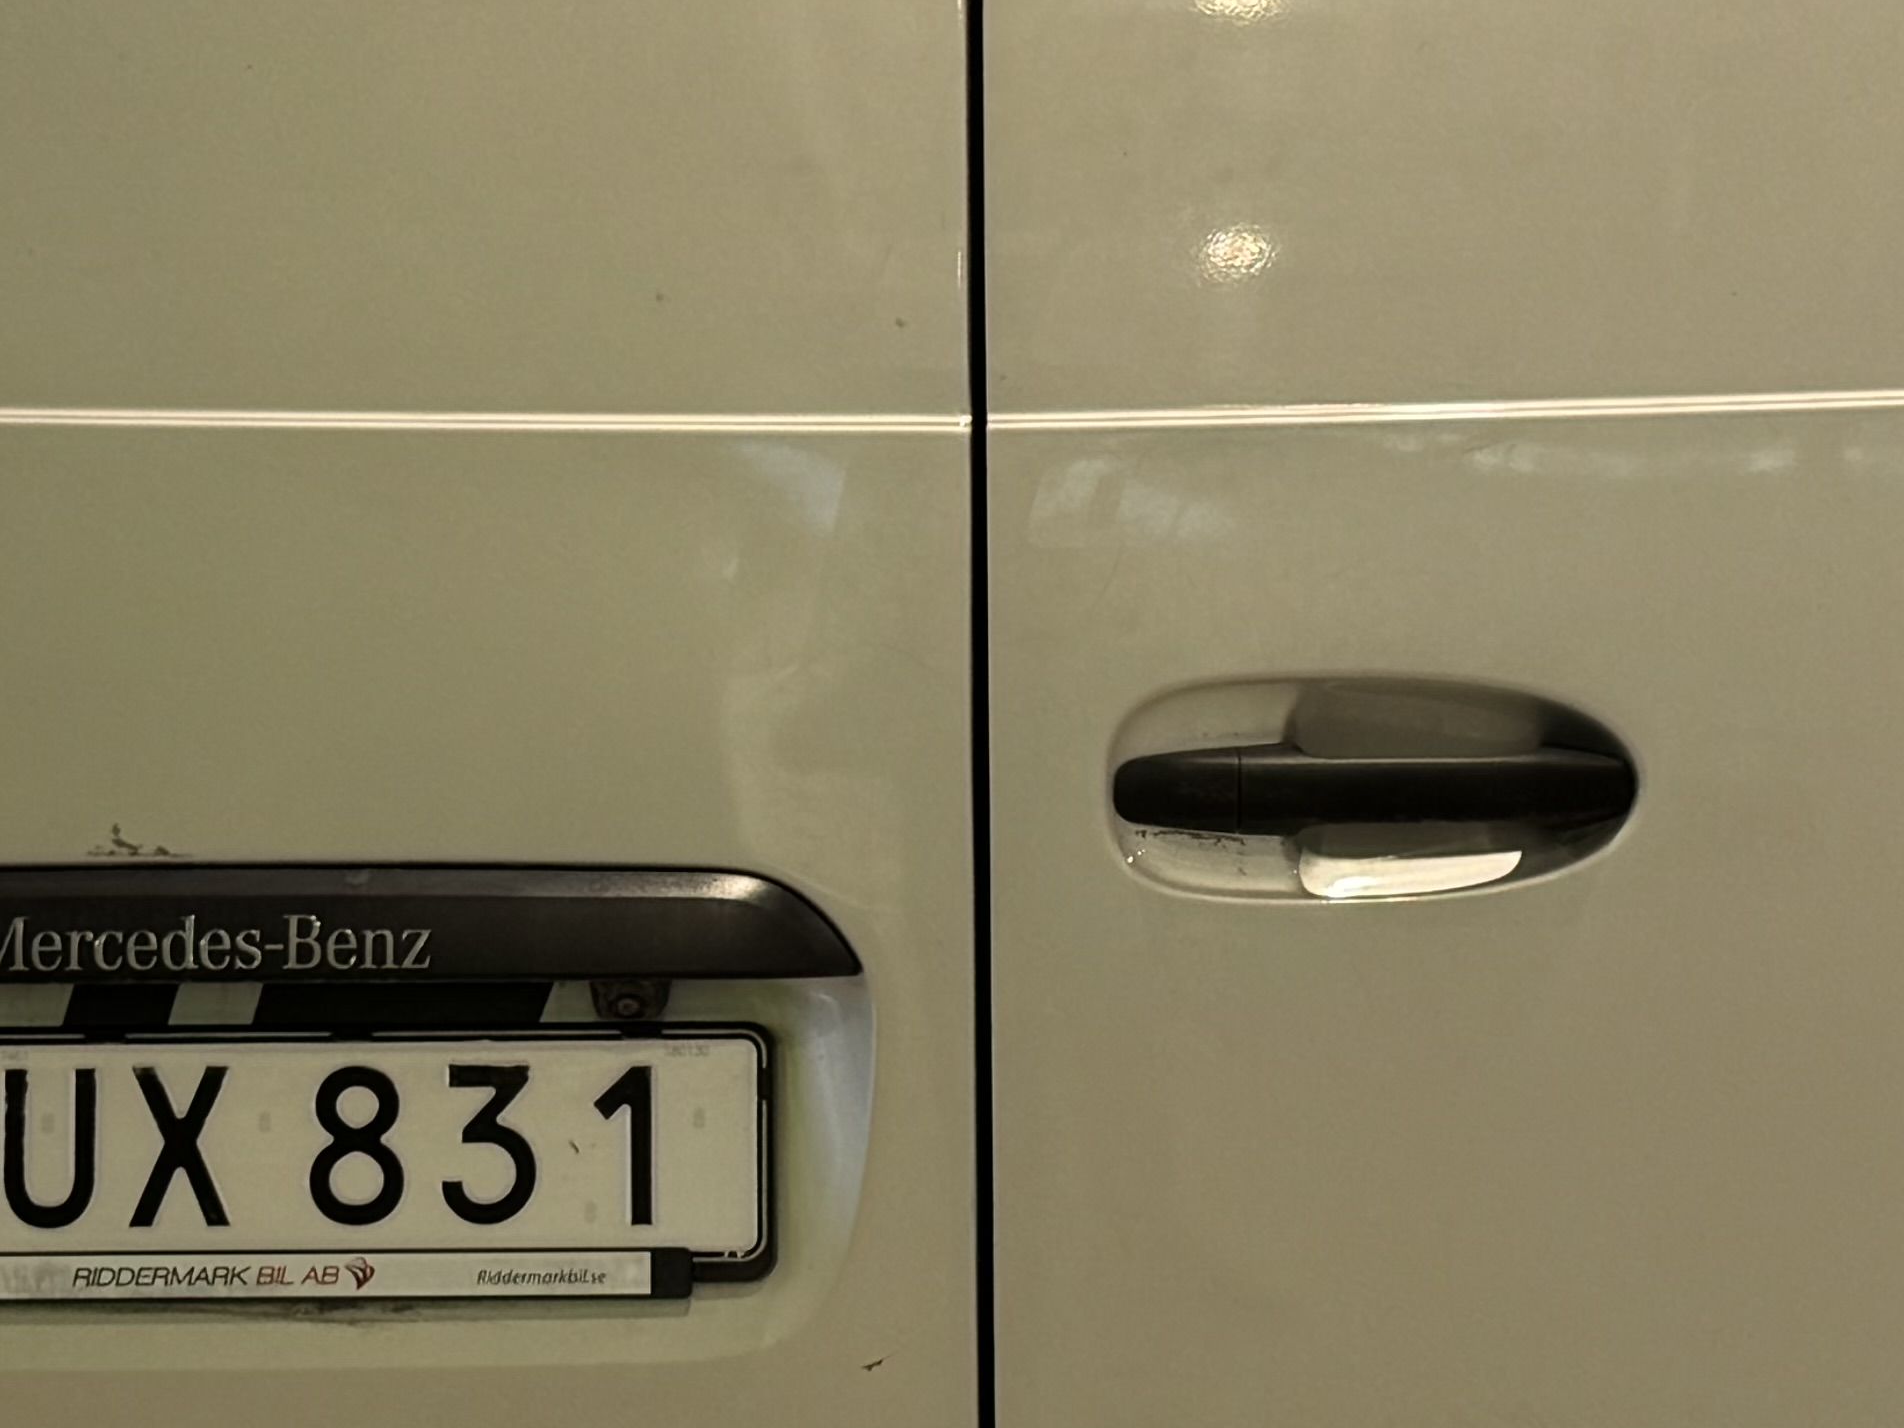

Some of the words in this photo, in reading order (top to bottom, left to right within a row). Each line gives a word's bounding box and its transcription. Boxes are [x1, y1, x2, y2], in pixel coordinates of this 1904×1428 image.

[308, 1064, 653, 1226] 831
[72, 1265, 251, 1288] RIDDERMARK
[255, 1265, 295, 1286] BIL
[300, 1265, 340, 1286] AB
